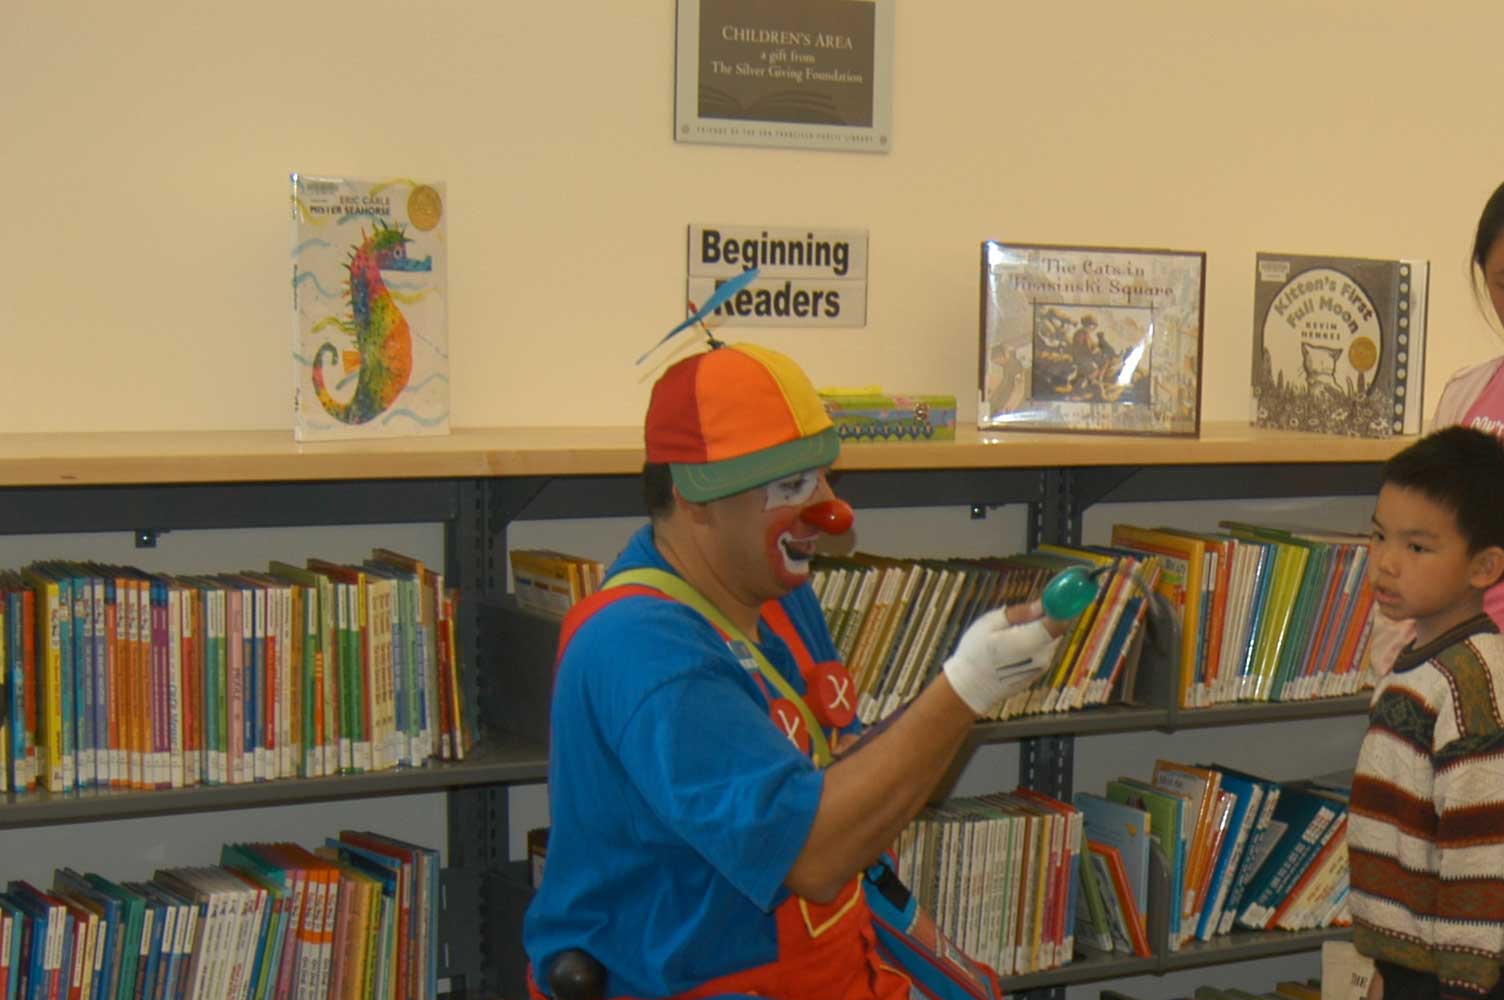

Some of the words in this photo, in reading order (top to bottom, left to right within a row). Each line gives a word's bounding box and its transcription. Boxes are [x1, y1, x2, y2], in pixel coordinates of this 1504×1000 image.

[722, 25, 811, 46] CHILDREN'S
[815, 33, 853, 49] AREA
[769, 50, 786, 63] gift
[790, 50, 815, 63] from
[712, 61, 732, 74] The
[736, 62, 765, 77] Silver
[768, 66, 802, 83] Giving
[806, 67, 863, 83] Foundation
[344, 206, 391, 216] SEAHORSE
[702, 229, 849, 276] Beginning
[1041, 257, 1076, 274] The
[1082, 259, 1121, 275] Cats
[1108, 283, 1174, 304] Square
[1274, 276, 1337, 316] Kitten's
[1340, 279, 1373, 322] First
[1286, 299, 1315, 329] Full
[1319, 295, 1360, 334] Moon
